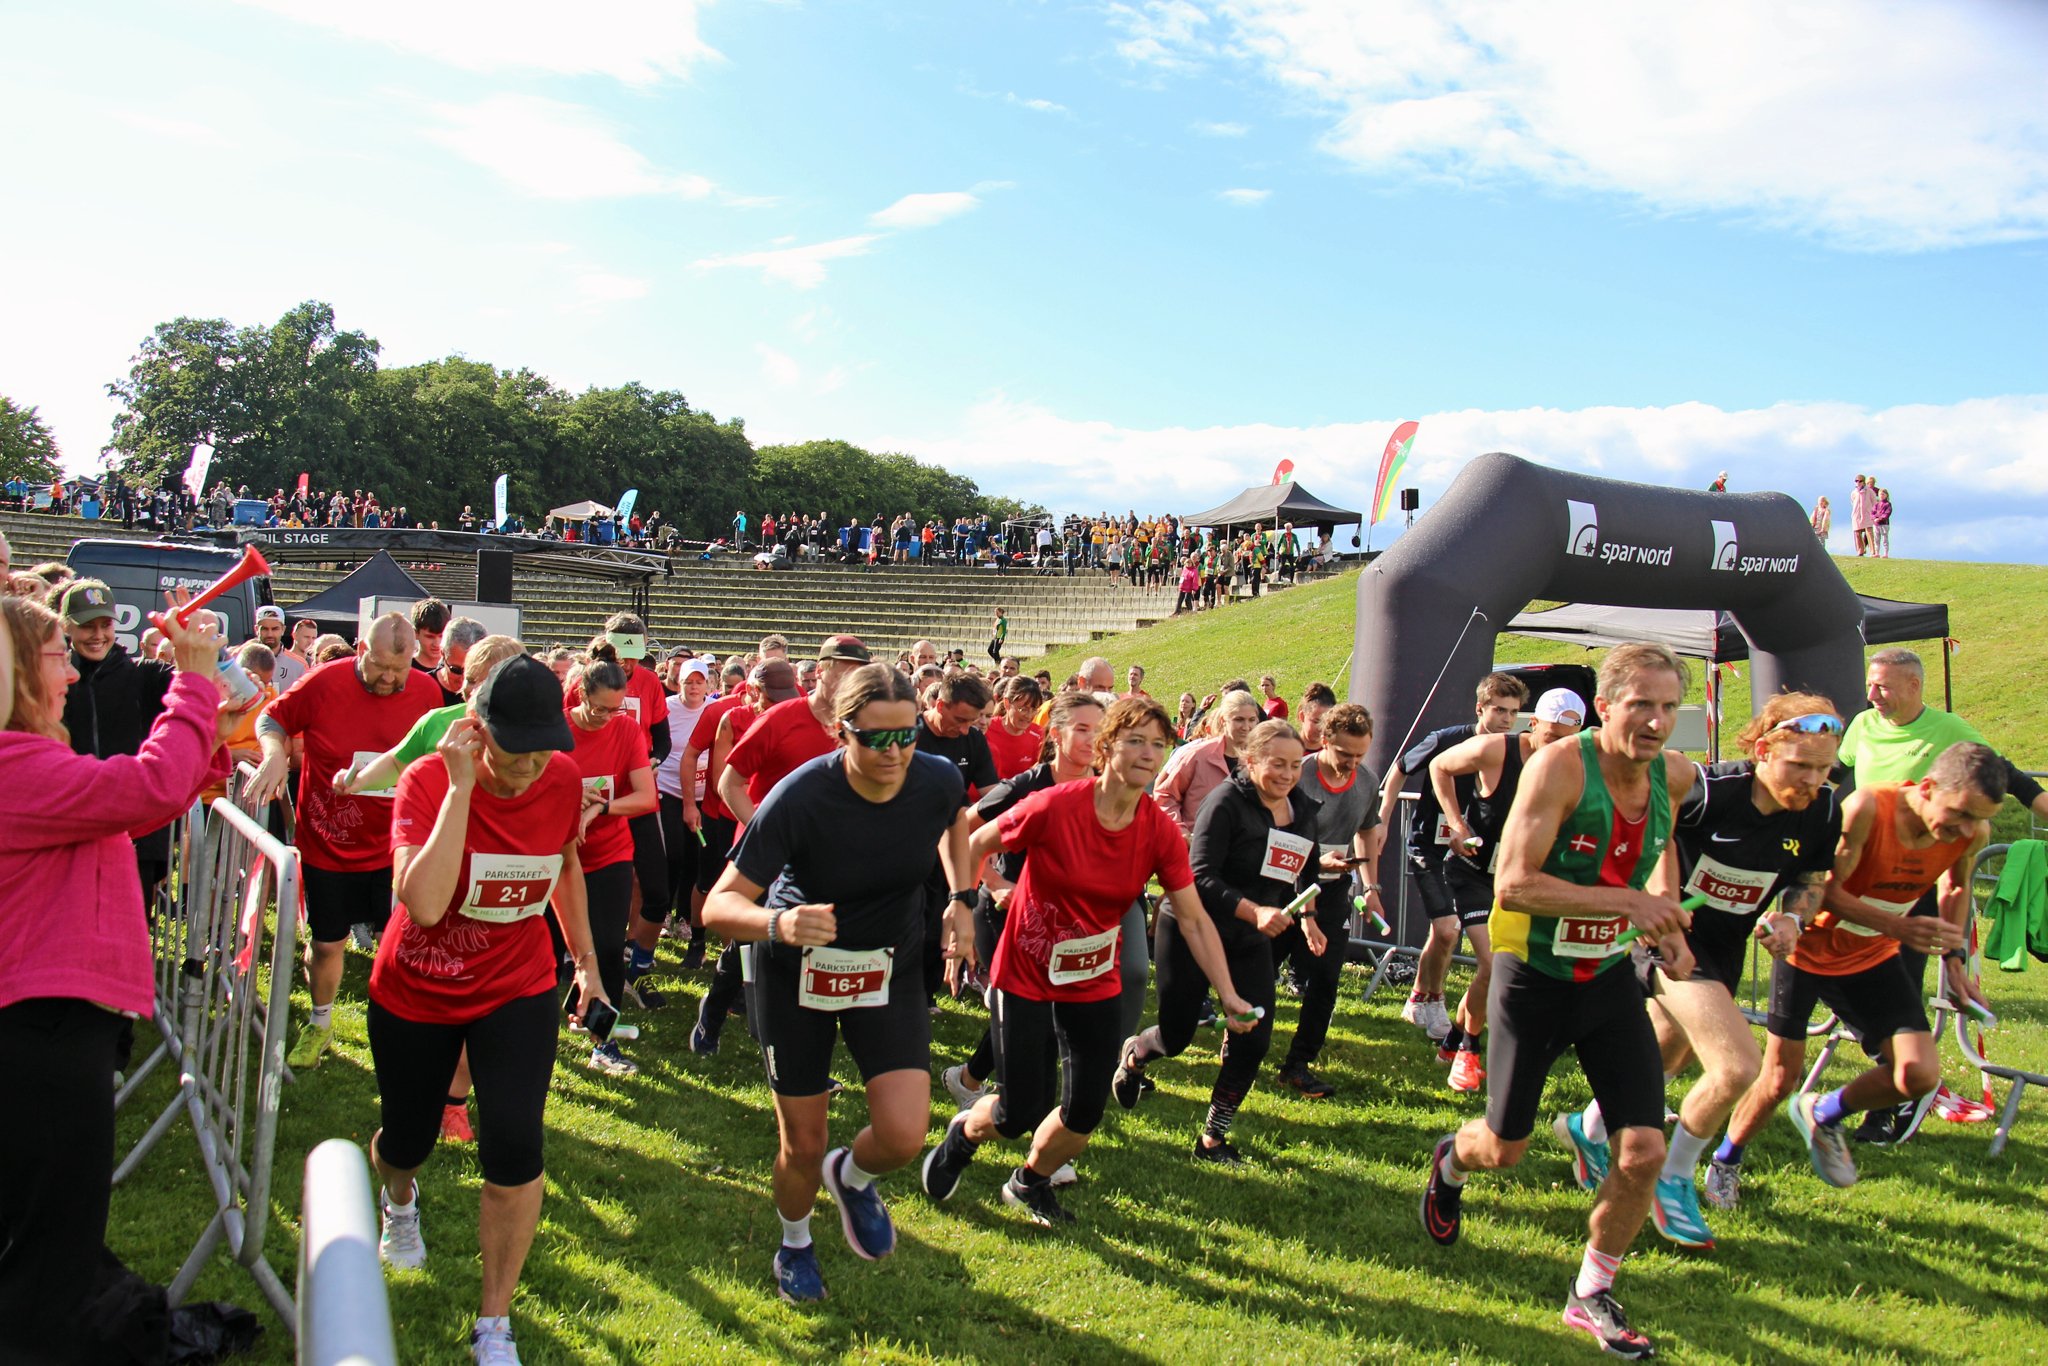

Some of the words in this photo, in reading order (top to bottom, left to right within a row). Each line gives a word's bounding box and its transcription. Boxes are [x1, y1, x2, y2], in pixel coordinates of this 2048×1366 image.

[284, 533, 329, 544] STAGE
[161, 576, 176, 586] OB
[179, 577, 216, 589] SUPPO
[1280, 853, 1300, 869] 22-1
[485, 870, 543, 879] PARKSTAFET
[1707, 868, 1756, 885] PARKSTAFET
[499, 886, 528, 903] 2-1
[1709, 882, 1752, 900] 160-1
[1577, 922, 1620, 940] 115-1
[815, 961, 873, 972] PARKSTAFET
[1078, 954, 1098, 968] 1-1
[828, 976, 865, 993] 16-1
